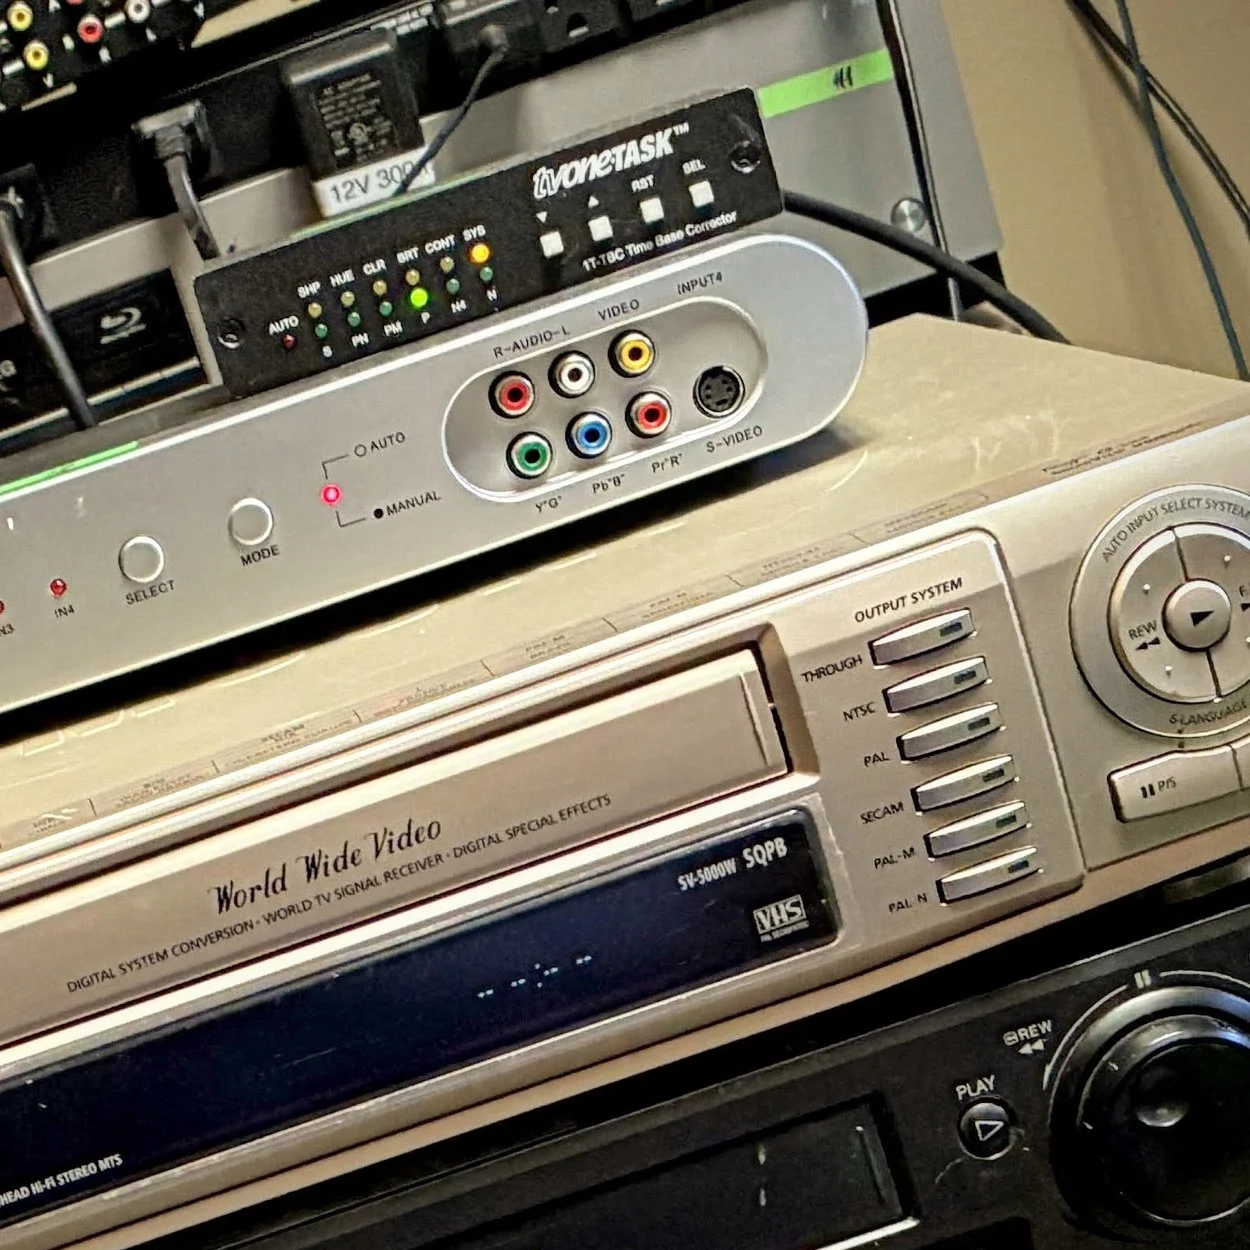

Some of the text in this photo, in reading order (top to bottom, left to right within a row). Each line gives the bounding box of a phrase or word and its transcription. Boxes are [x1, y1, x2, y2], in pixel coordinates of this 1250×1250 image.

[425, 234, 455, 255] CONT
[582, 211, 737, 272] 1T-TBC Time Base Corrector
[363, 258, 387, 276] CLR
[397, 247, 419, 264] BRT
[298, 280, 321, 299] SHP
[329, 269, 355, 288] HUE
[677, 271, 723, 295] INPUT4
[597, 299, 640, 321] VIDEO
[268, 316, 299, 335] AUTO
[369, 431, 407, 452] AUTO
[706, 425, 763, 452] S-VIDEO
[386, 490, 442, 518] MANUAL
[1101, 499, 1204, 562] AUTO INPUT SELECT
[240, 544, 281, 568] MODE
[125, 579, 177, 605] SELECT
[854, 577, 963, 623] OUTPUT SYSTEM
[54, 603, 75, 619] IN4
[1128, 620, 1157, 640] REW
[802, 654, 863, 684] THROUGH
[843, 701, 876, 722] NTSC
[864, 752, 890, 766] PAL
[860, 802, 905, 825] SECAM
[207, 817, 442, 914] World Wide Video
[678, 836, 788, 891] SV-5000W SQPB
[66, 795, 612, 993] DIGITAL SYSTEM CONVERSION WORLD TV SIGNAL RECEIVER DIGITAL SPECIAL EFFECTS
[756, 897, 803, 932] VHS
[888, 900, 913, 913] PAL
[1017, 1020, 1052, 1041] REW
[956, 1074, 996, 1101] PLAY
[55, 1164, 99, 1189] STEREO
[98, 1153, 124, 1172] MTS
